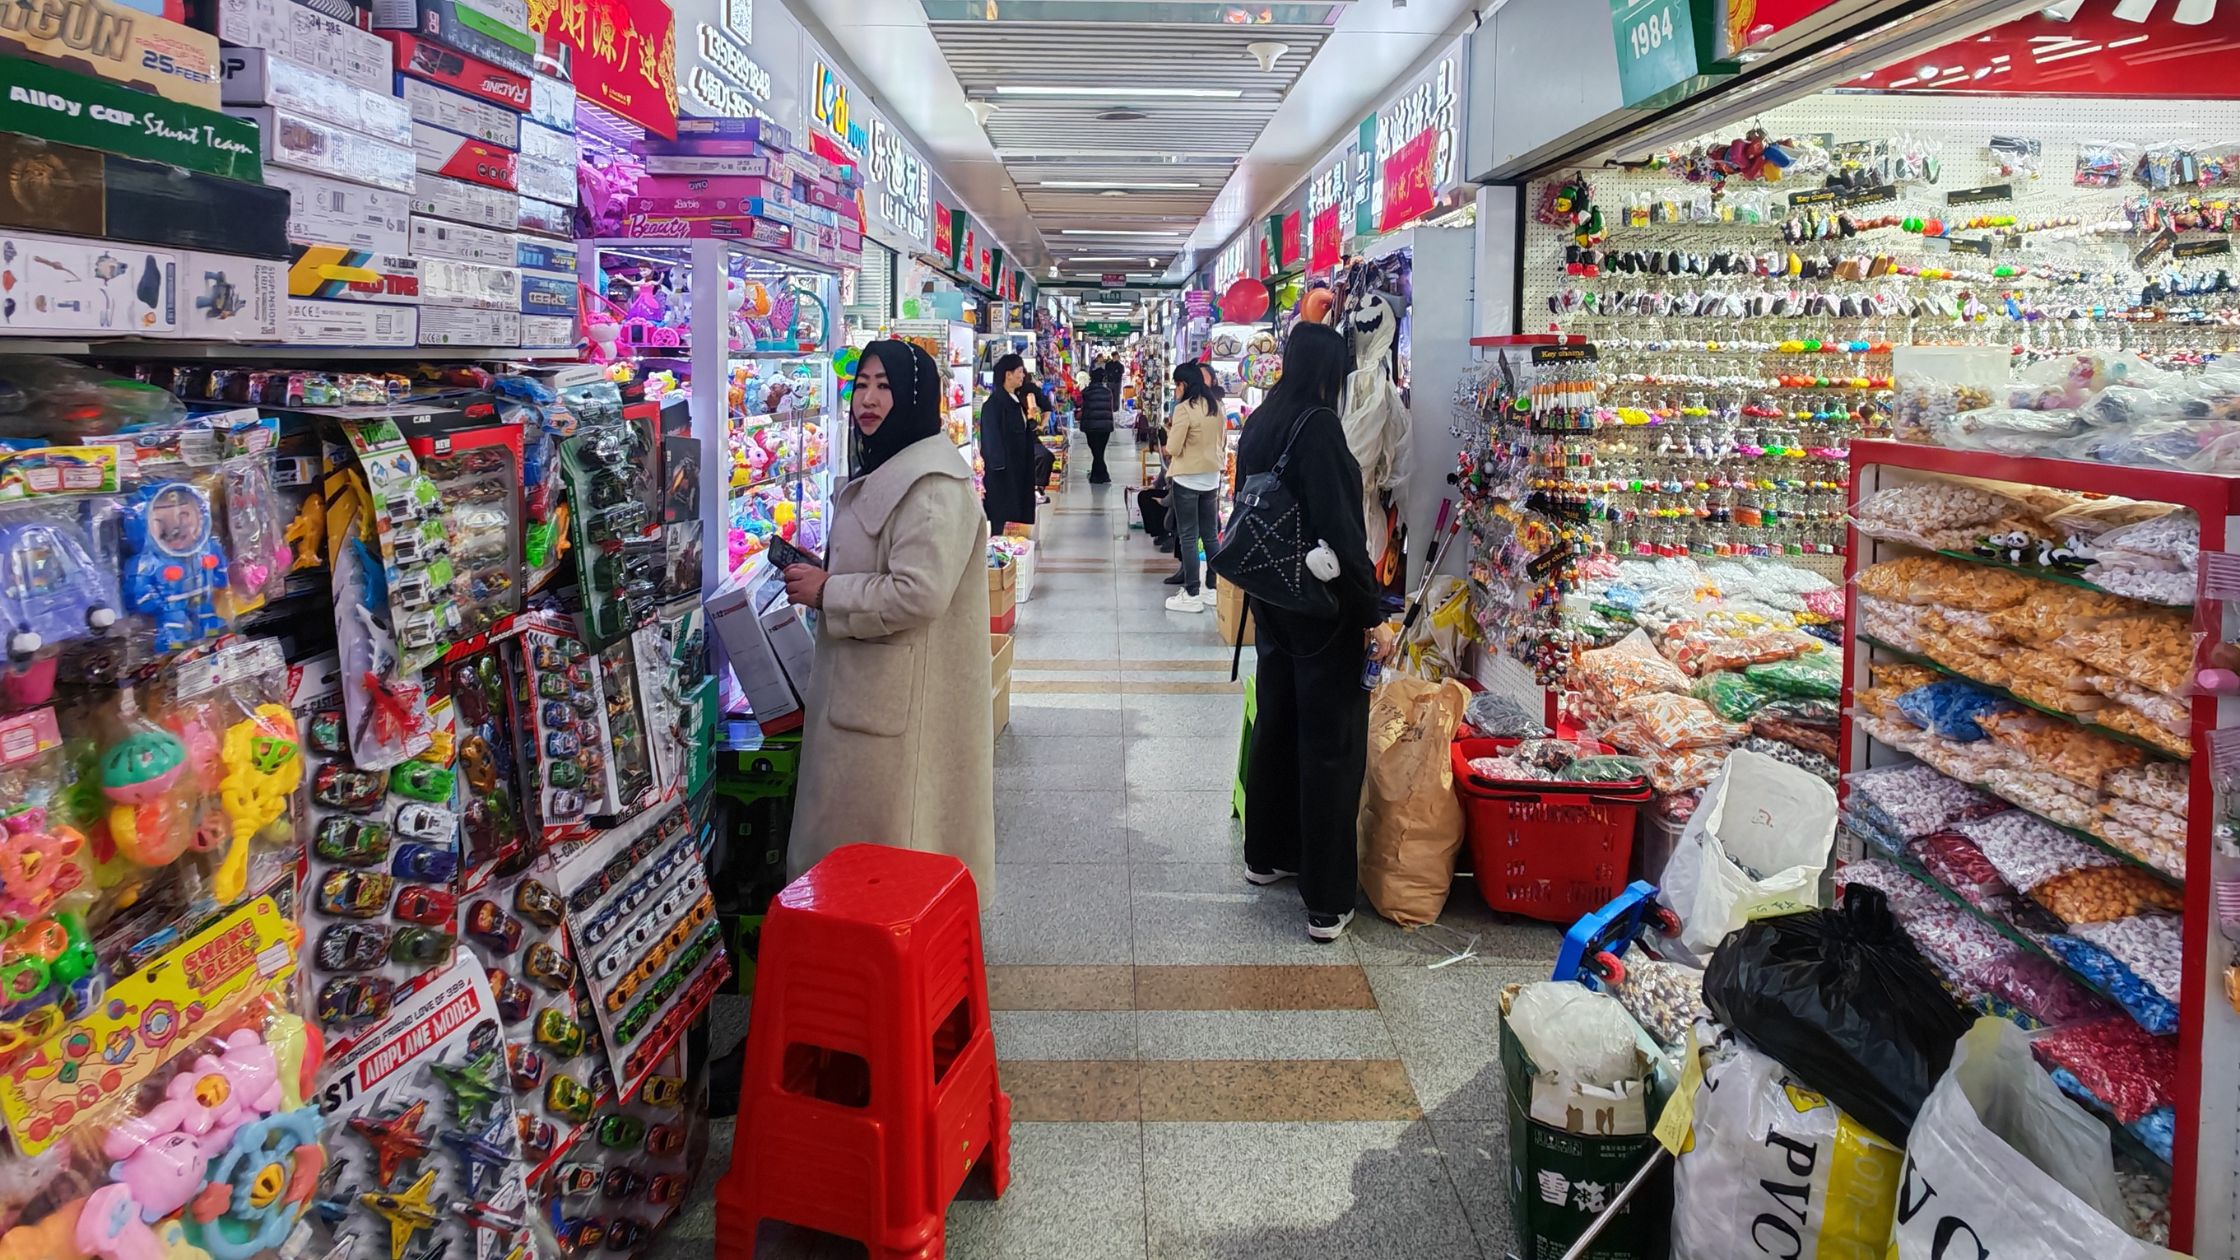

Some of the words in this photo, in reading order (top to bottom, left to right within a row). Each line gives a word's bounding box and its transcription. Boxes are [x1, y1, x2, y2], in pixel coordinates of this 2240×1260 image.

[1630, 6, 1674, 60] 1984
[142, 49, 174, 74] 25
[478, 77, 530, 105] RACING
[9, 85, 83, 118] Alloy
[202, 125, 254, 155] Team
[673, 199, 700, 210] Barbie
[629, 213, 691, 239] Beauty
[1541, 350, 1558, 359] Key
[412, 415, 432, 424] CAR
[182, 918, 257, 976] SHAKE
[201, 942, 253, 983] BELL
[364, 1019, 432, 1087] AIRPLANE
[431, 993, 478, 1040] MODEL
[1750, 1122, 1819, 1260] PVC
